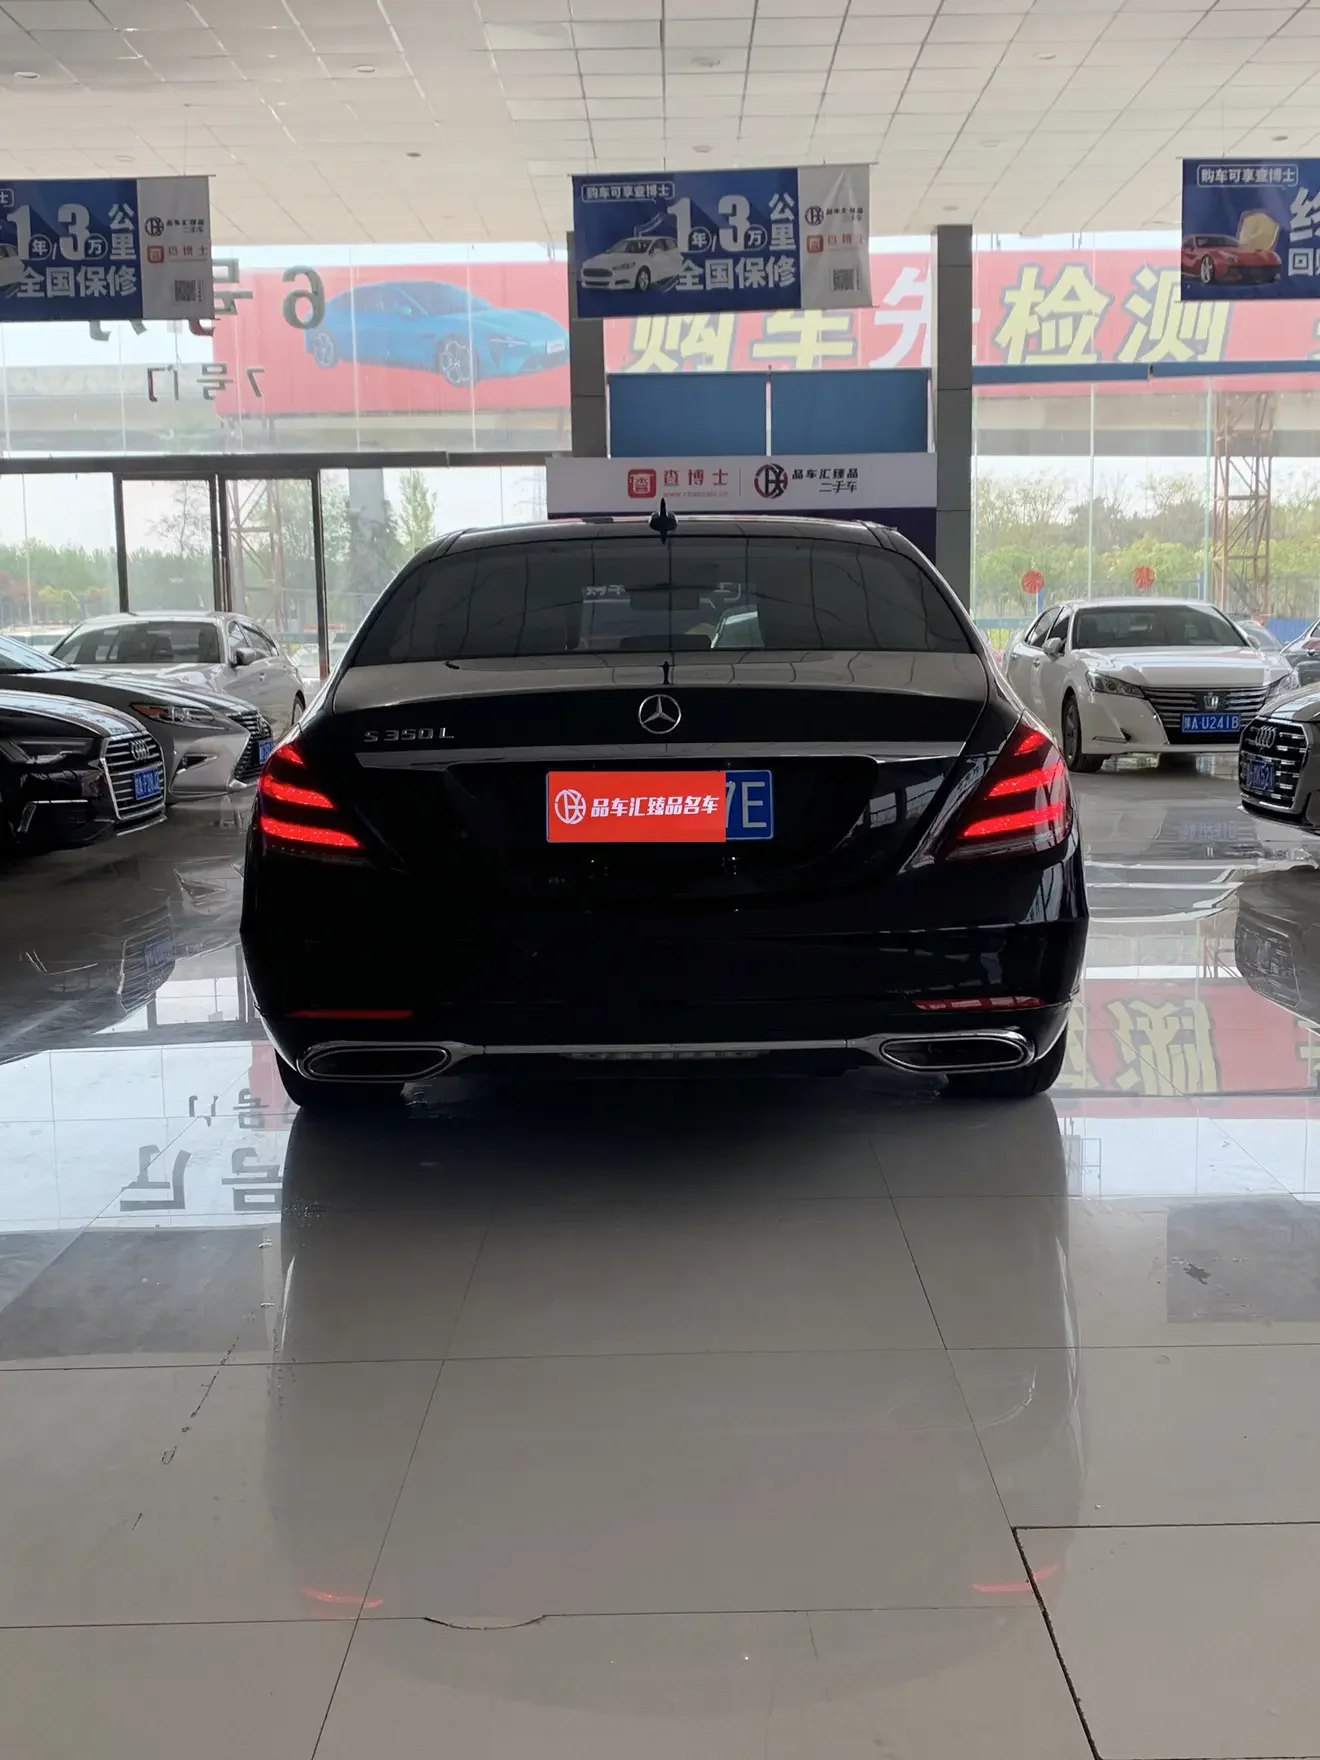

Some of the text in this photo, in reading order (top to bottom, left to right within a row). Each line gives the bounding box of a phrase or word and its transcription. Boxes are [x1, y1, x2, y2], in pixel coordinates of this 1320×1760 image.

[1201, 168, 1296, 183] 购车可享查博士
[16, 265, 138, 298] 全国保修
[675, 255, 797, 292] 全国保修
[590, 794, 720, 818] 品车汇臻品名车
